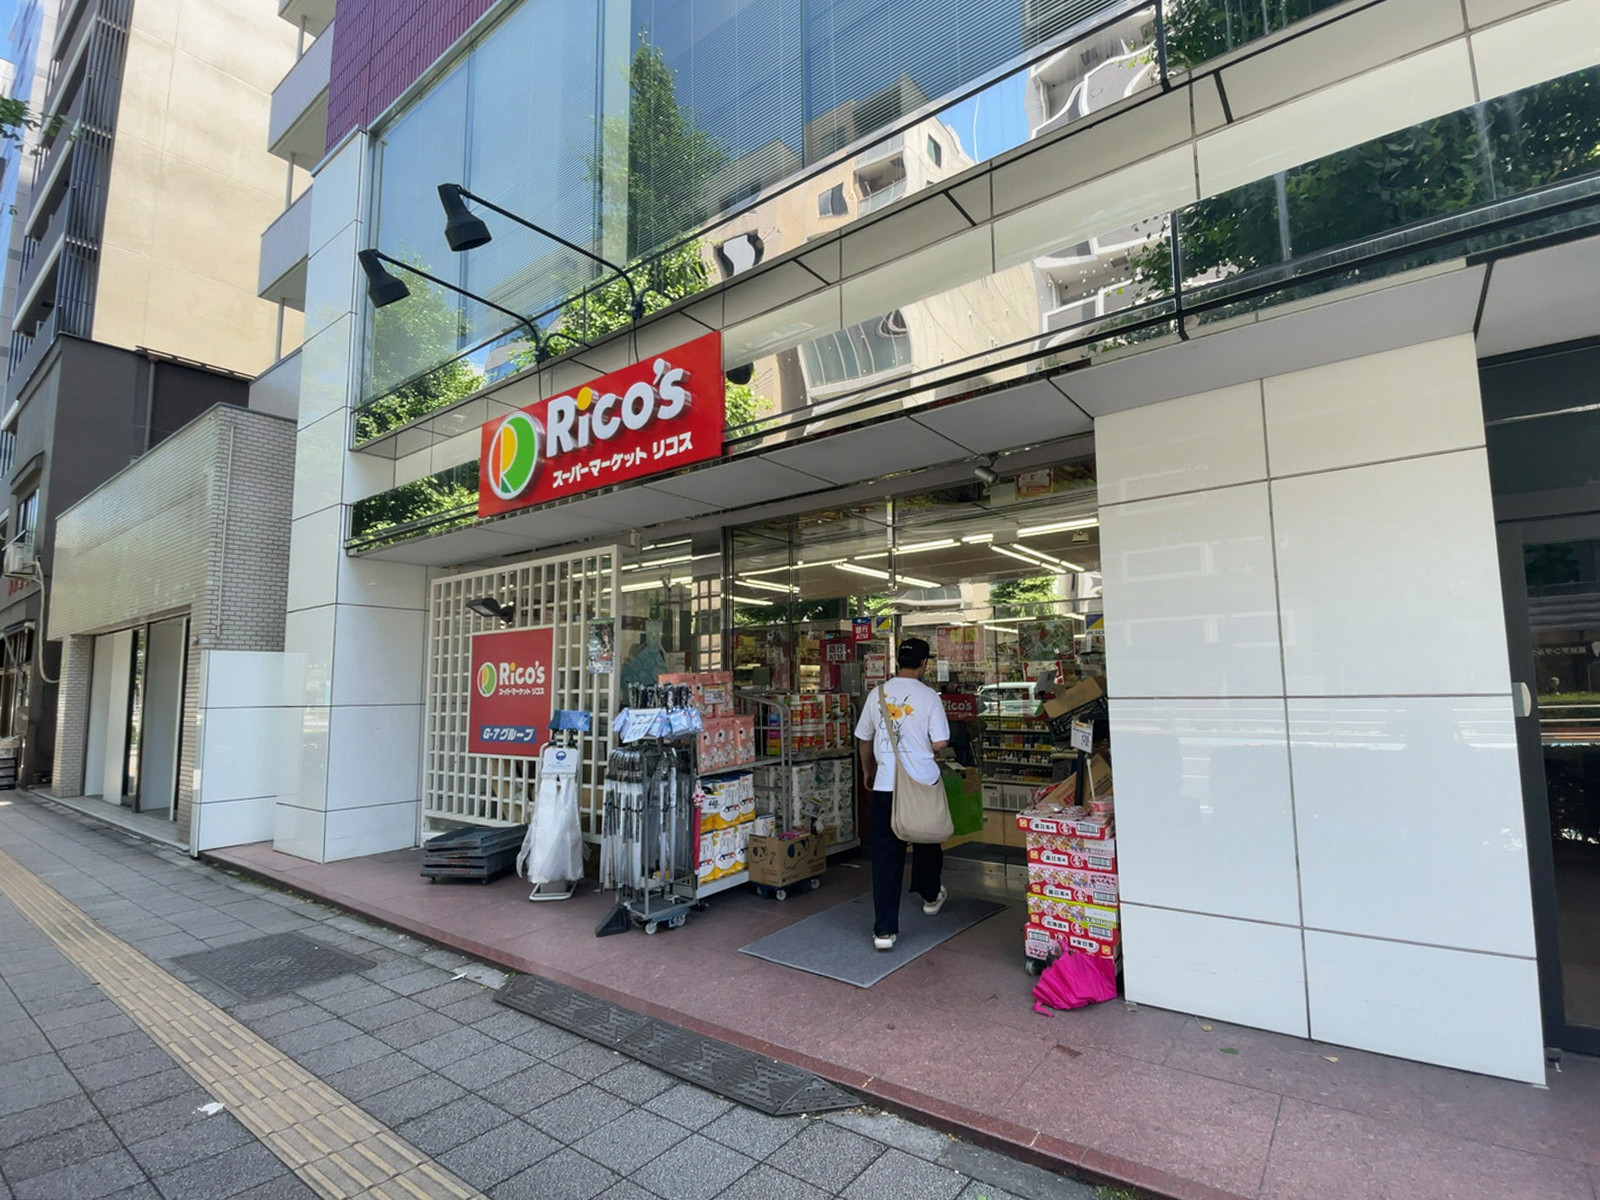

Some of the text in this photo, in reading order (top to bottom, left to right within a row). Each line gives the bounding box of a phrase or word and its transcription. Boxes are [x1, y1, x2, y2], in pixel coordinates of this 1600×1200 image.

[552, 431, 694, 488] スーパーマーケット リコス
